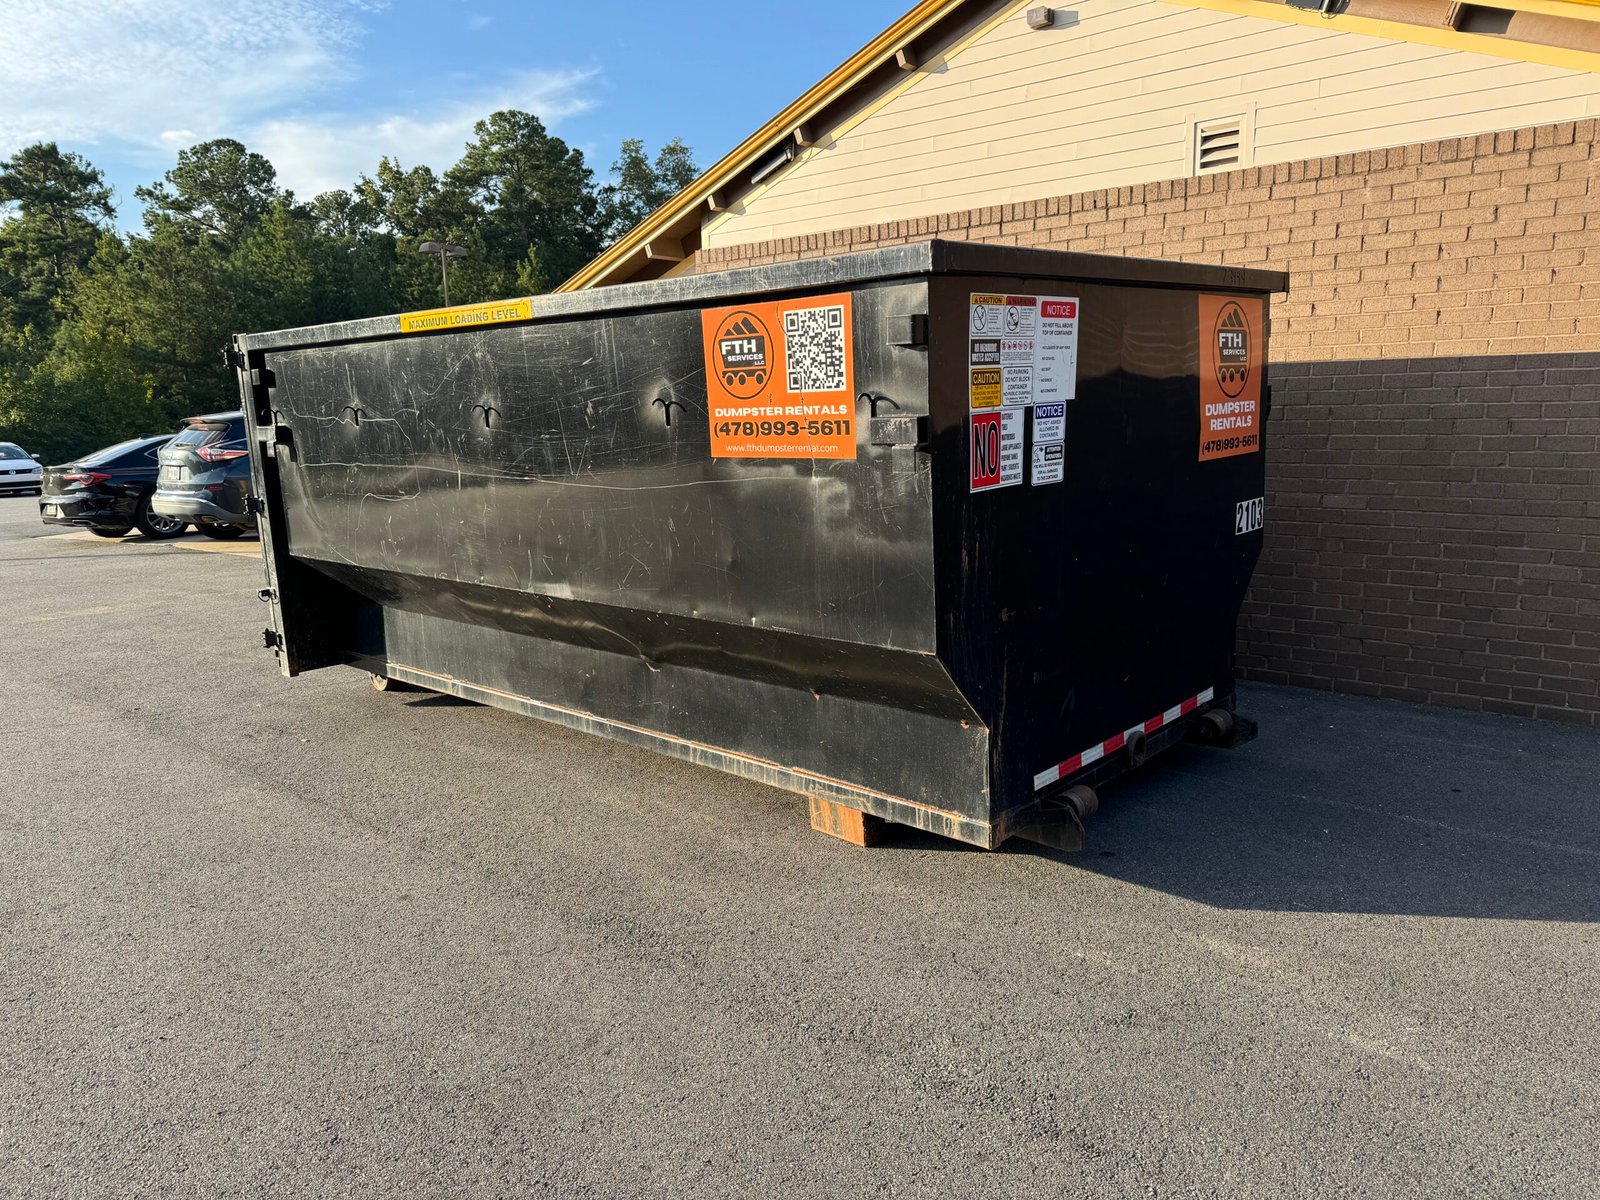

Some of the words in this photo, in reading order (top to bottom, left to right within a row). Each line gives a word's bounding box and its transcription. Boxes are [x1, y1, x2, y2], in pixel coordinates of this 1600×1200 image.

[1047, 305, 1070, 315] NOTICE
[408, 318, 448, 330] MAXIMUM
[450, 312, 488, 324] LOADING
[492, 309, 521, 320] LEVEL
[721, 339, 756, 354] FTH
[1219, 333, 1242, 347] FTH
[974, 373, 1000, 384] CAUTION
[715, 407, 784, 417] DUMPSTER
[785, 404, 848, 415] RENTALS
[1037, 406, 1062, 417] NOTICE
[1205, 400, 1256, 416] DUMPSTER
[714, 420, 850, 438] (478)993-5611
[1210, 415, 1252, 431] RENTALS
[726, 444, 838, 453] www.fthdumpsterrental.com
[974, 421, 999, 478] NO
[1202, 434, 1258, 455] (478)993-5611
[1237, 499, 1263, 533] 2103
